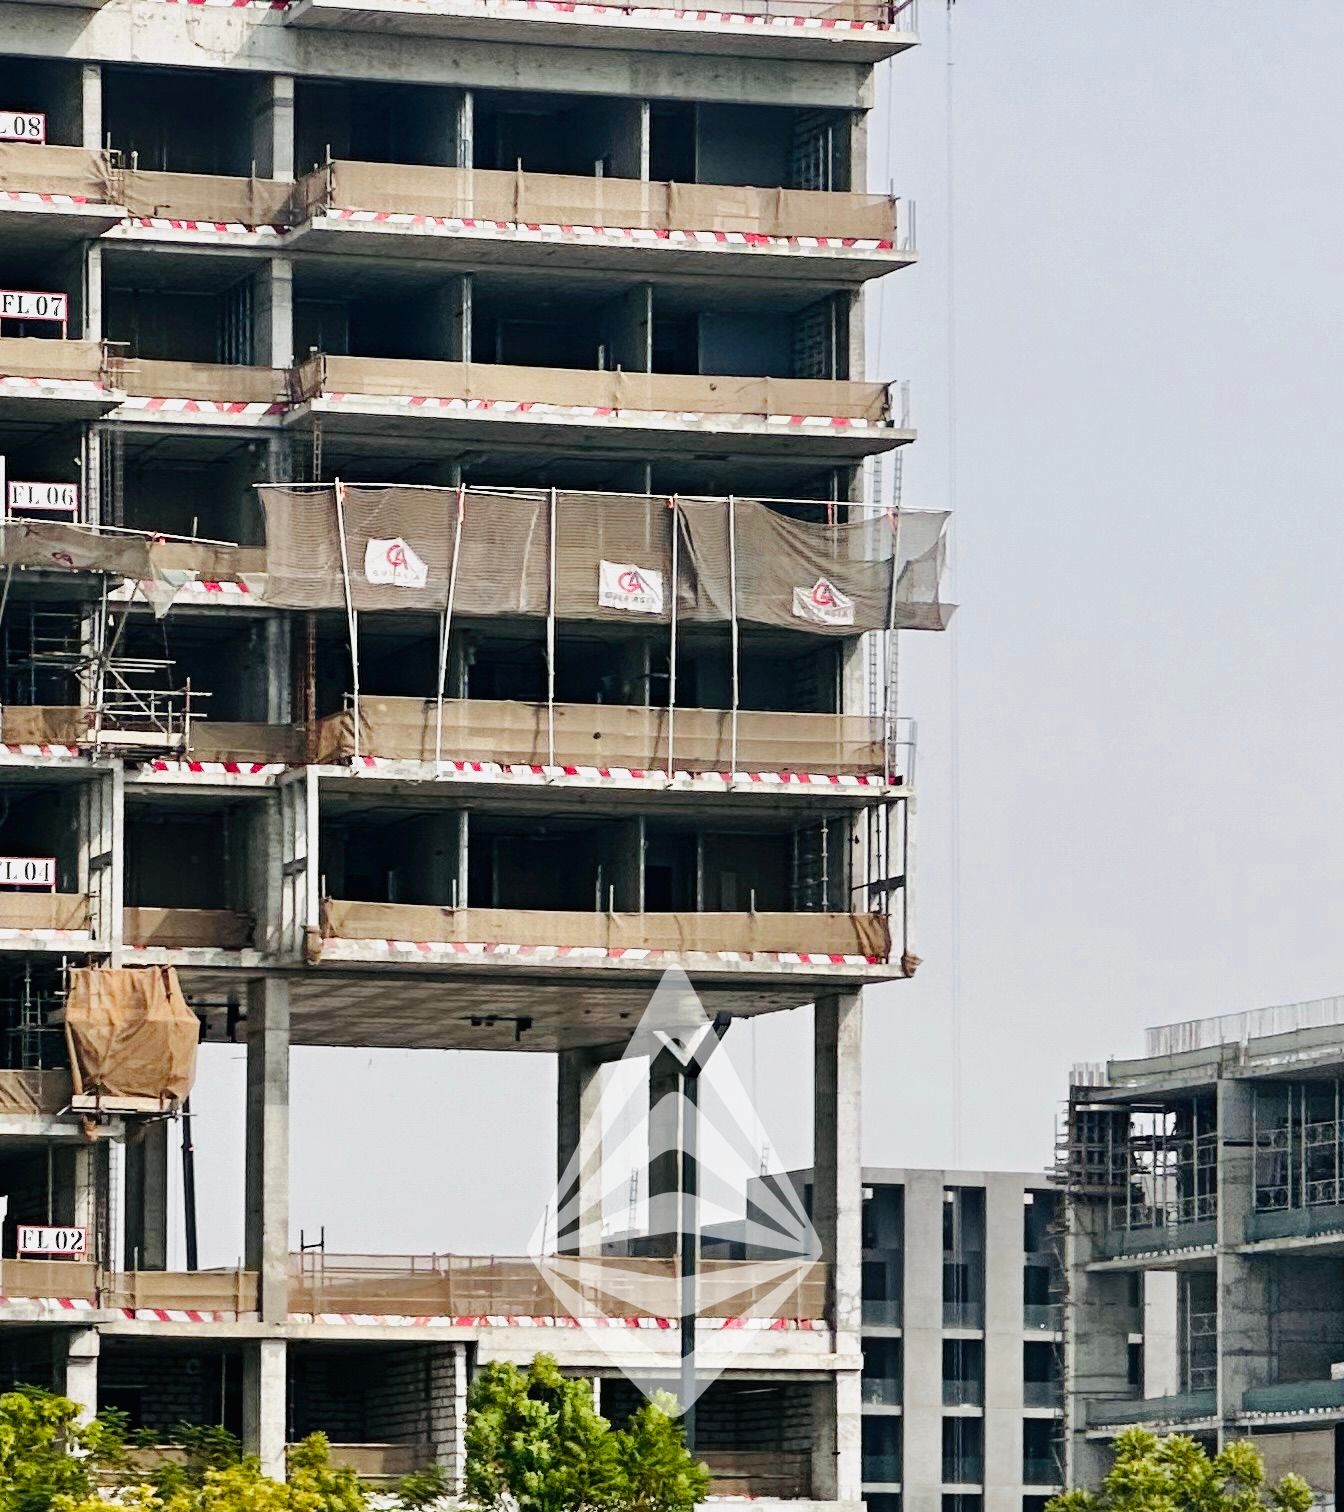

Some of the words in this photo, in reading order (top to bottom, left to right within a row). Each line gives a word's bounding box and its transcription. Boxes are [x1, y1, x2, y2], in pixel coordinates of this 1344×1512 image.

[14, 116, 41, 136] 08
[2, 295, 30, 314] FL
[36, 296, 63, 316] 07
[12, 485, 40, 504] FL
[47, 487, 74, 506] 06
[22, 1230, 49, 1249] FL
[55, 1231, 83, 1250] 02
